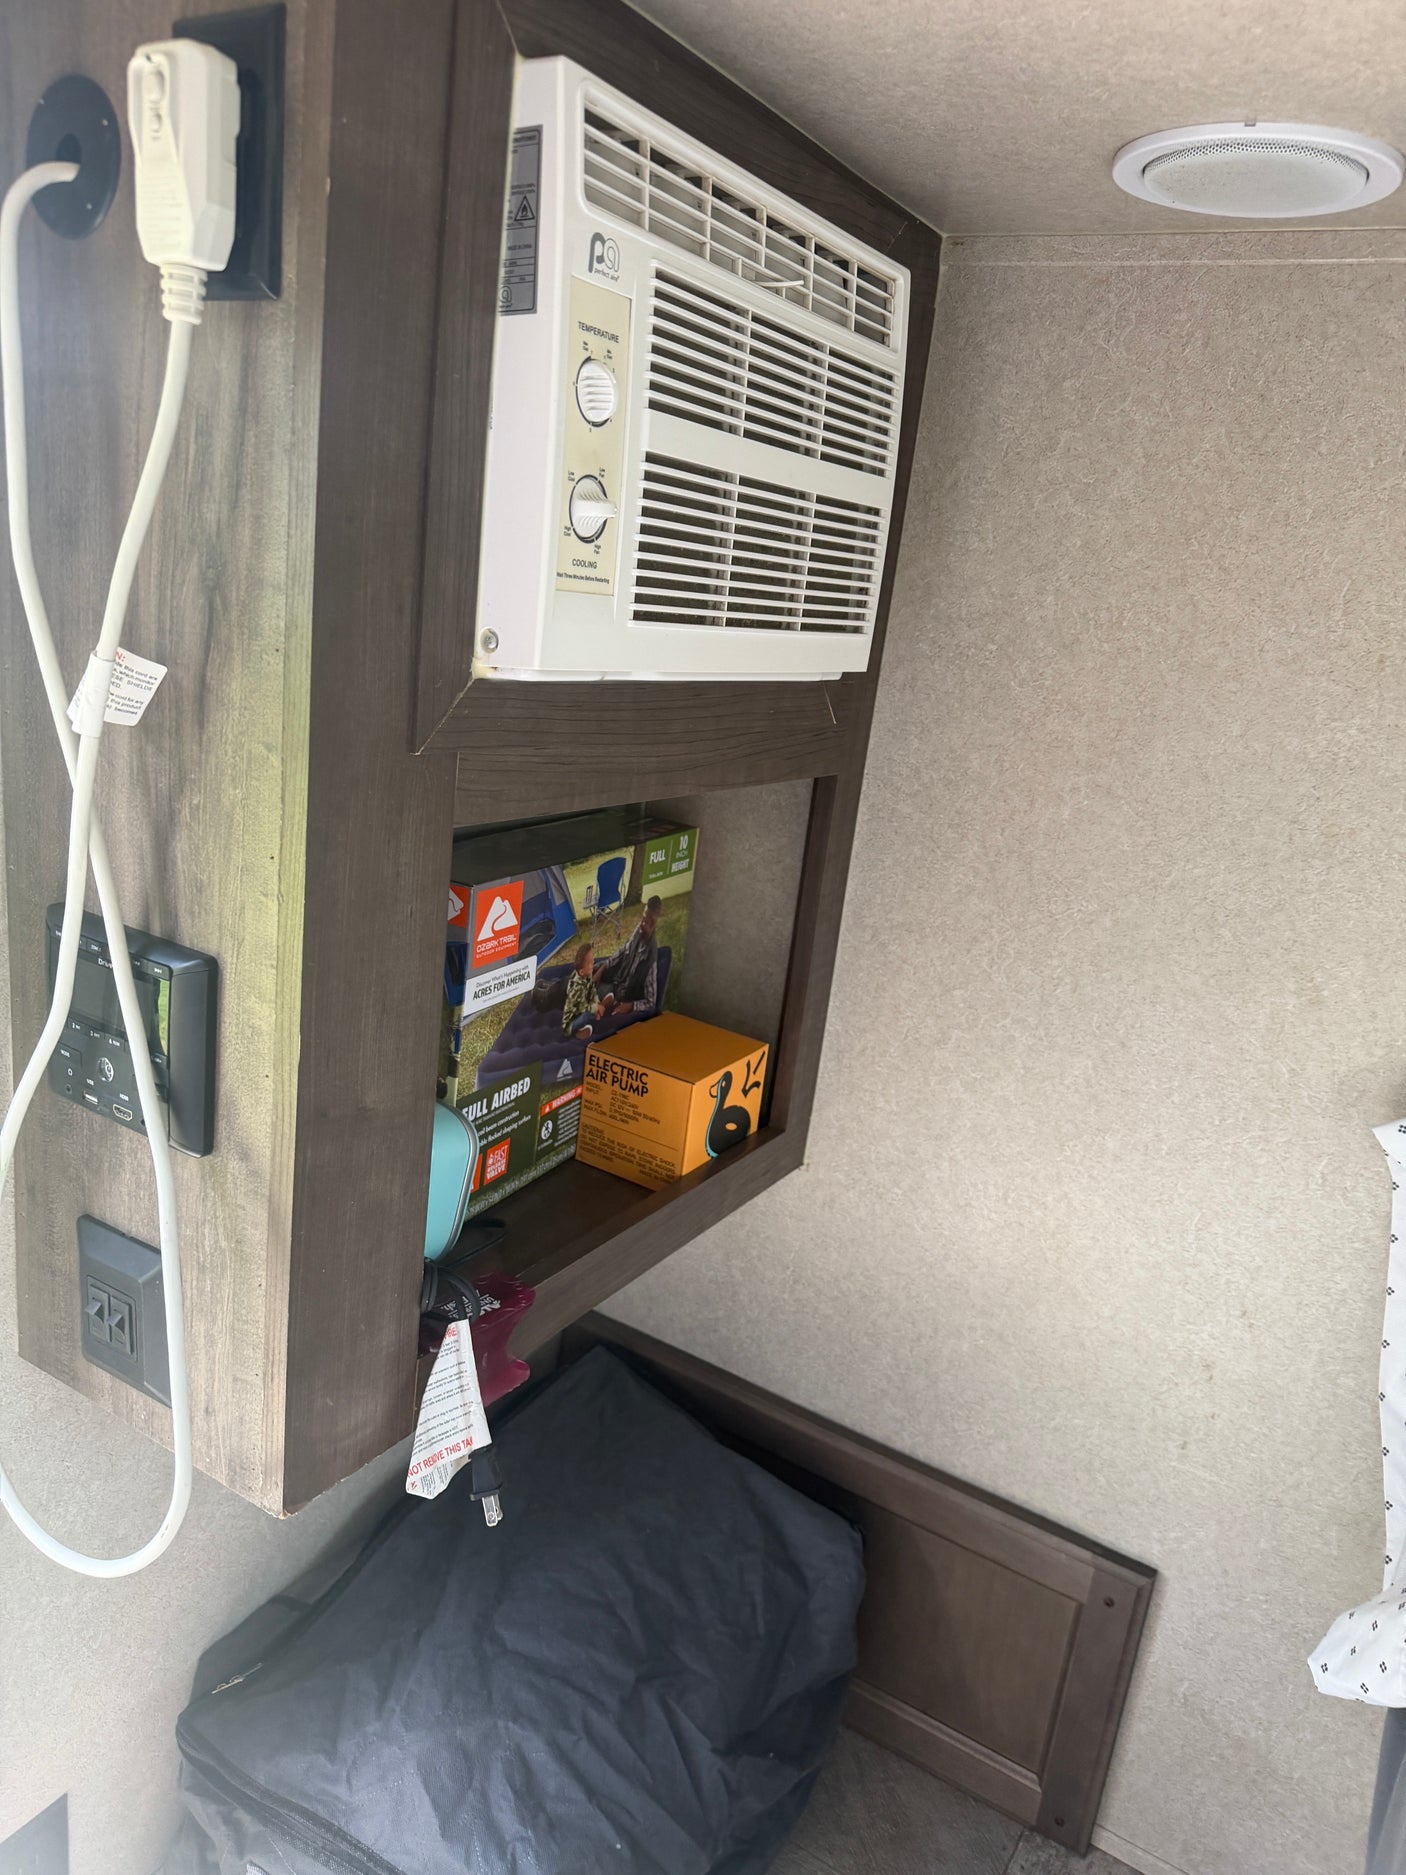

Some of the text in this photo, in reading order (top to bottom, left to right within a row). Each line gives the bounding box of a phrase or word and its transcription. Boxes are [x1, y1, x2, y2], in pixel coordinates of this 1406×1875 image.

[577, 321, 619, 343] TEMPERATURE
[572, 559, 597, 569] COOLING
[680, 835, 689, 850] 10
[649, 849, 666, 864] FULL
[476, 934, 517, 953] OZARK TRAIL
[473, 986, 492, 1001] ACRES
[493, 980, 505, 992] FOR
[506, 972, 531, 988] AMERICA
[476, 978, 492, 989] Discover
[503, 968, 522, 980] Happening
[589, 1054, 648, 1086] ELECTRIC
[586, 1068, 607, 1084] AIR
[611, 1076, 648, 1097] PUMP
[462, 1098, 488, 1121] FULL
[491, 1077, 531, 1110] AIRBED
[445, 1442, 462, 1457] THIS
